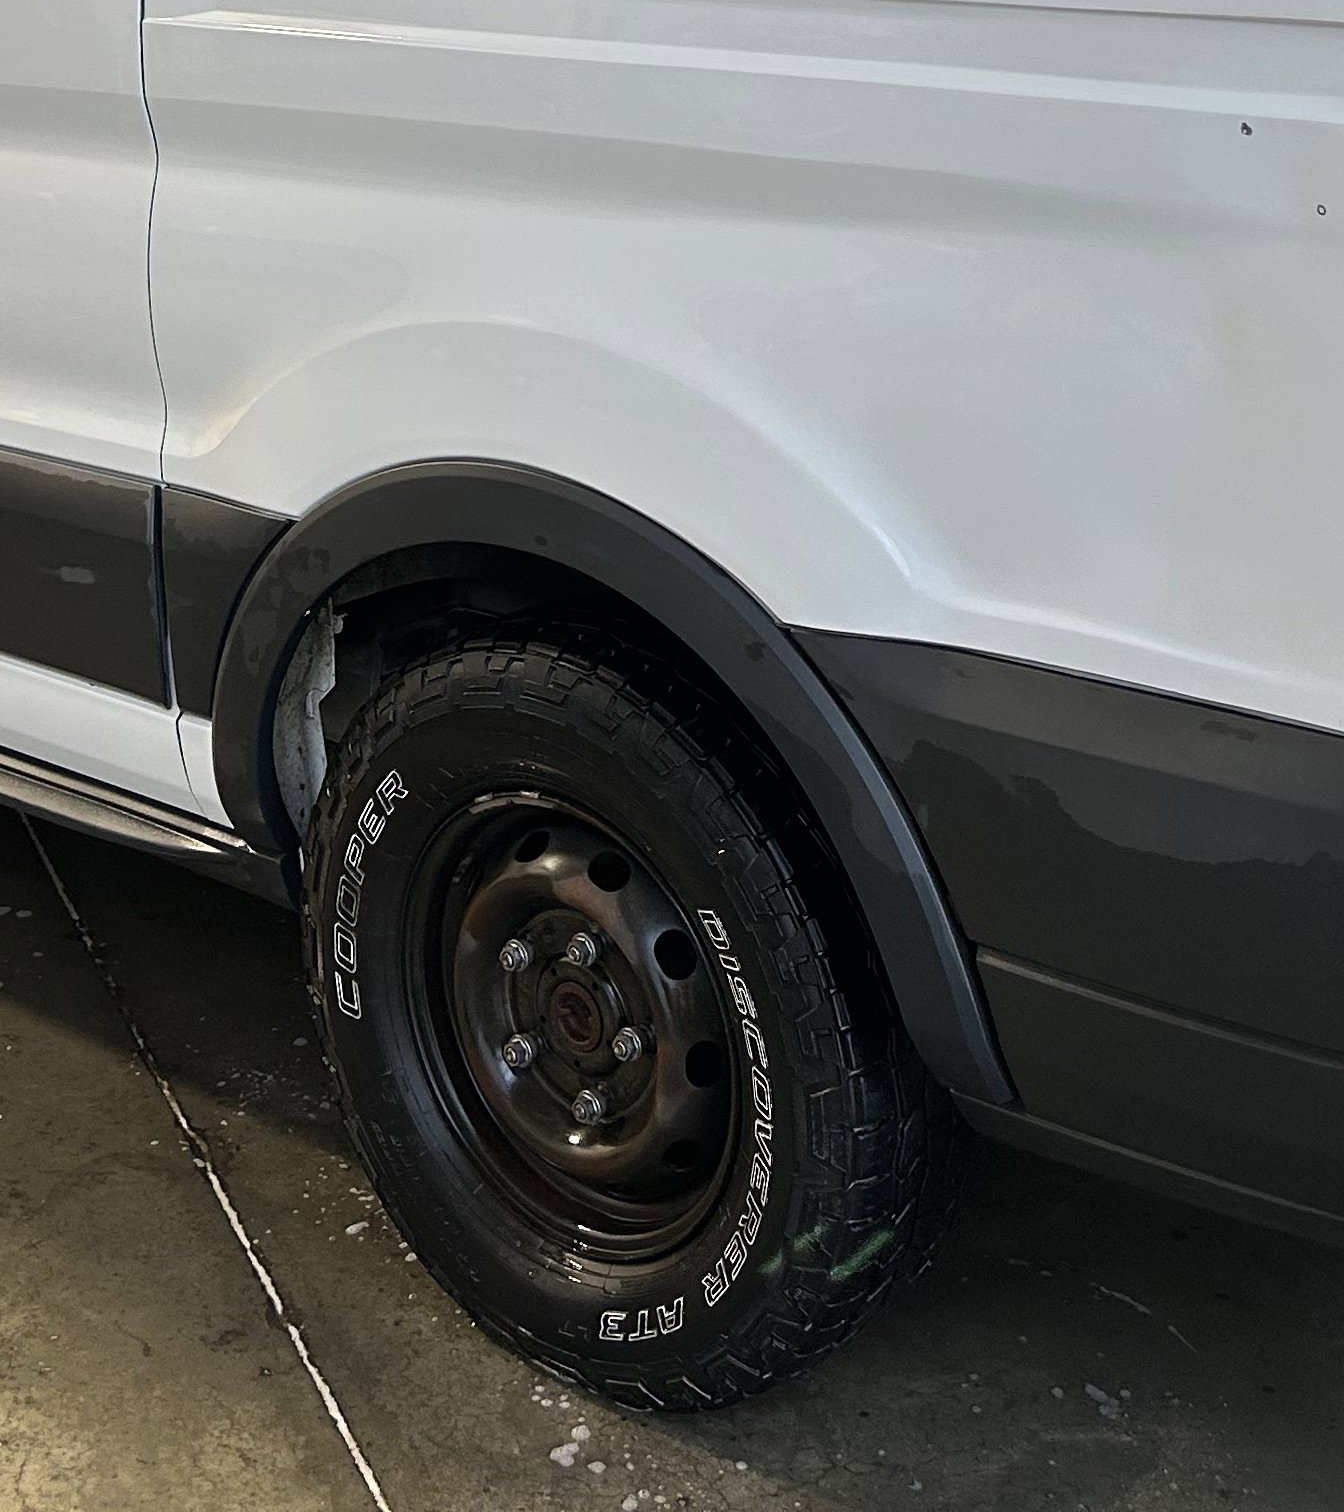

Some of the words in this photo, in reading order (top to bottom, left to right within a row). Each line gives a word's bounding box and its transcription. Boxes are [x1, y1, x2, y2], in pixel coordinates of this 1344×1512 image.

[332, 769, 409, 1019] COOPER
[696, 909, 776, 1307] DISCOVERER
[598, 1296, 685, 1342] AT3
